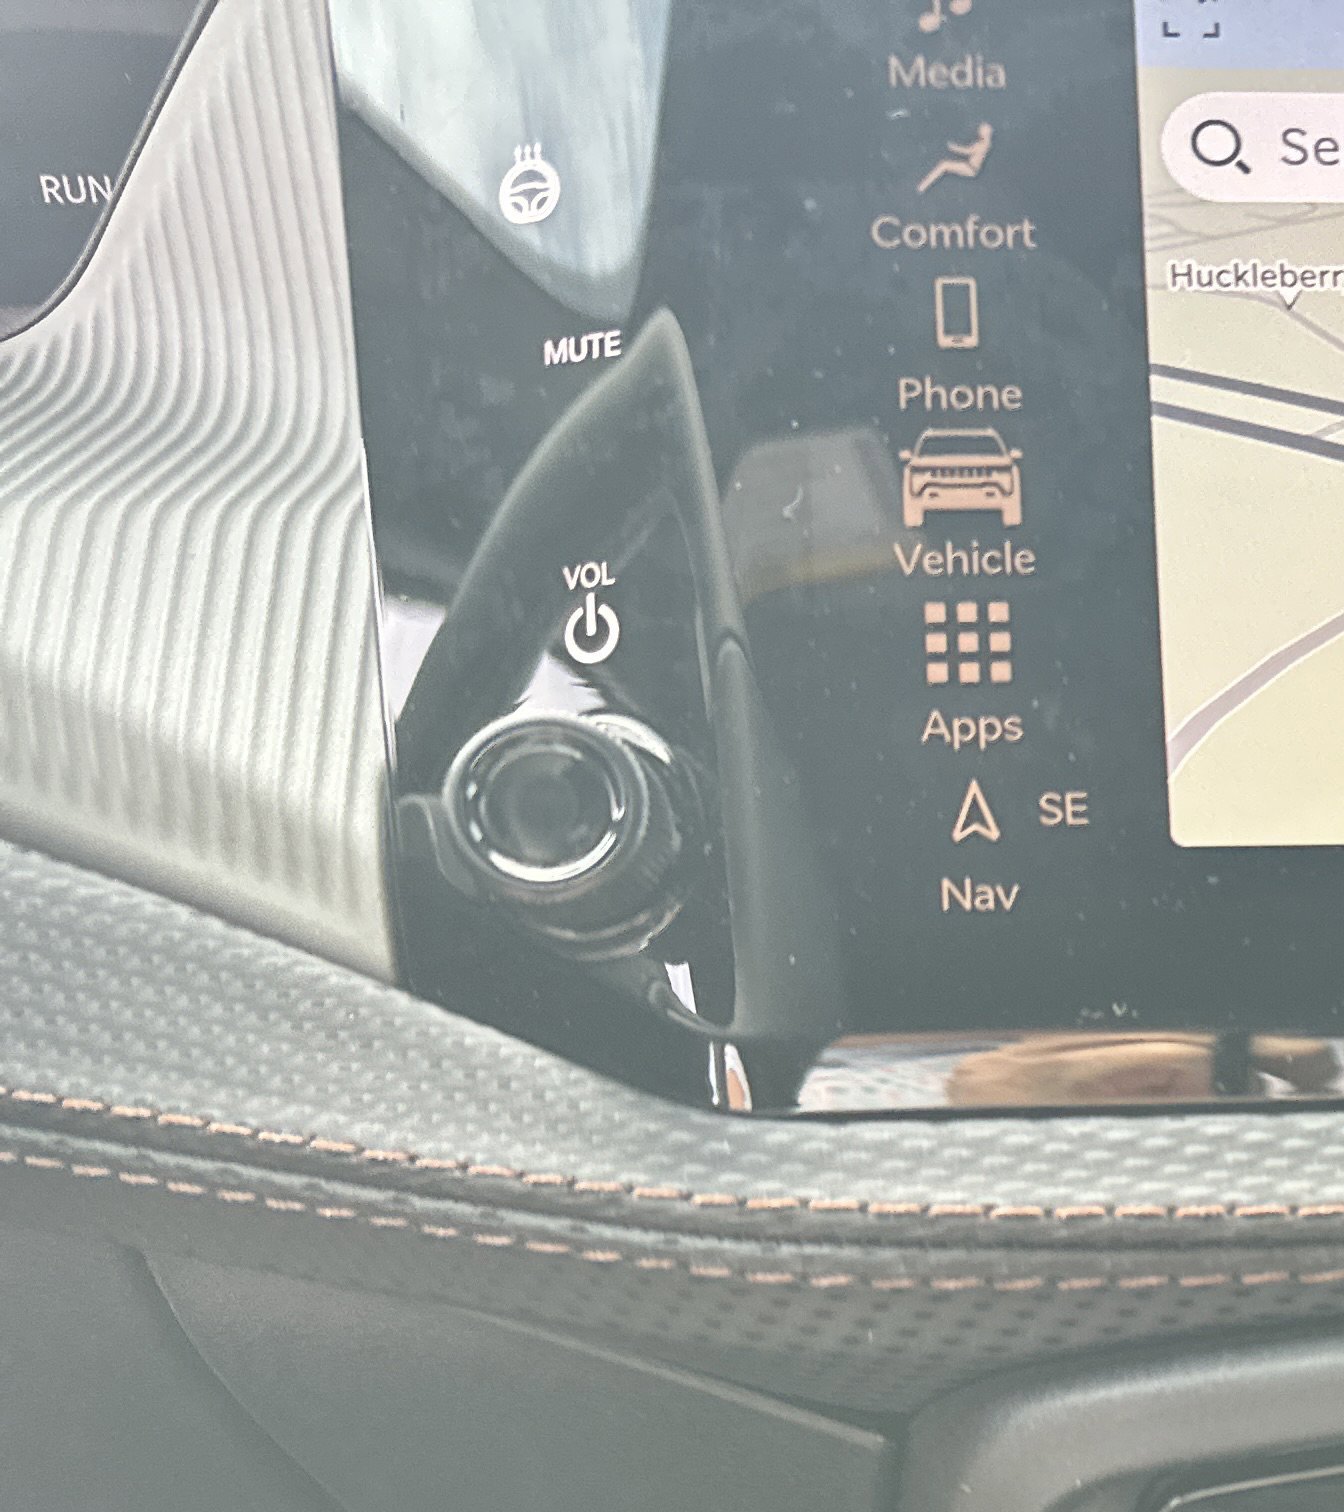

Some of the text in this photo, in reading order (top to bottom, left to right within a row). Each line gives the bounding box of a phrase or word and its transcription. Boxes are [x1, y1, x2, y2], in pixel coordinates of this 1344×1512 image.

[889, 55, 1006, 89] Media
[40, 174, 114, 204] RUN
[871, 215, 1037, 250] Comfort
[543, 329, 622, 366] MUTE
[899, 376, 1023, 411] Phone
[563, 561, 615, 590] VOL
[894, 541, 1036, 577] Vehicle
[921, 709, 1024, 751] Apps
[1038, 791, 1090, 826] SE
[940, 876, 1020, 913] Nav
